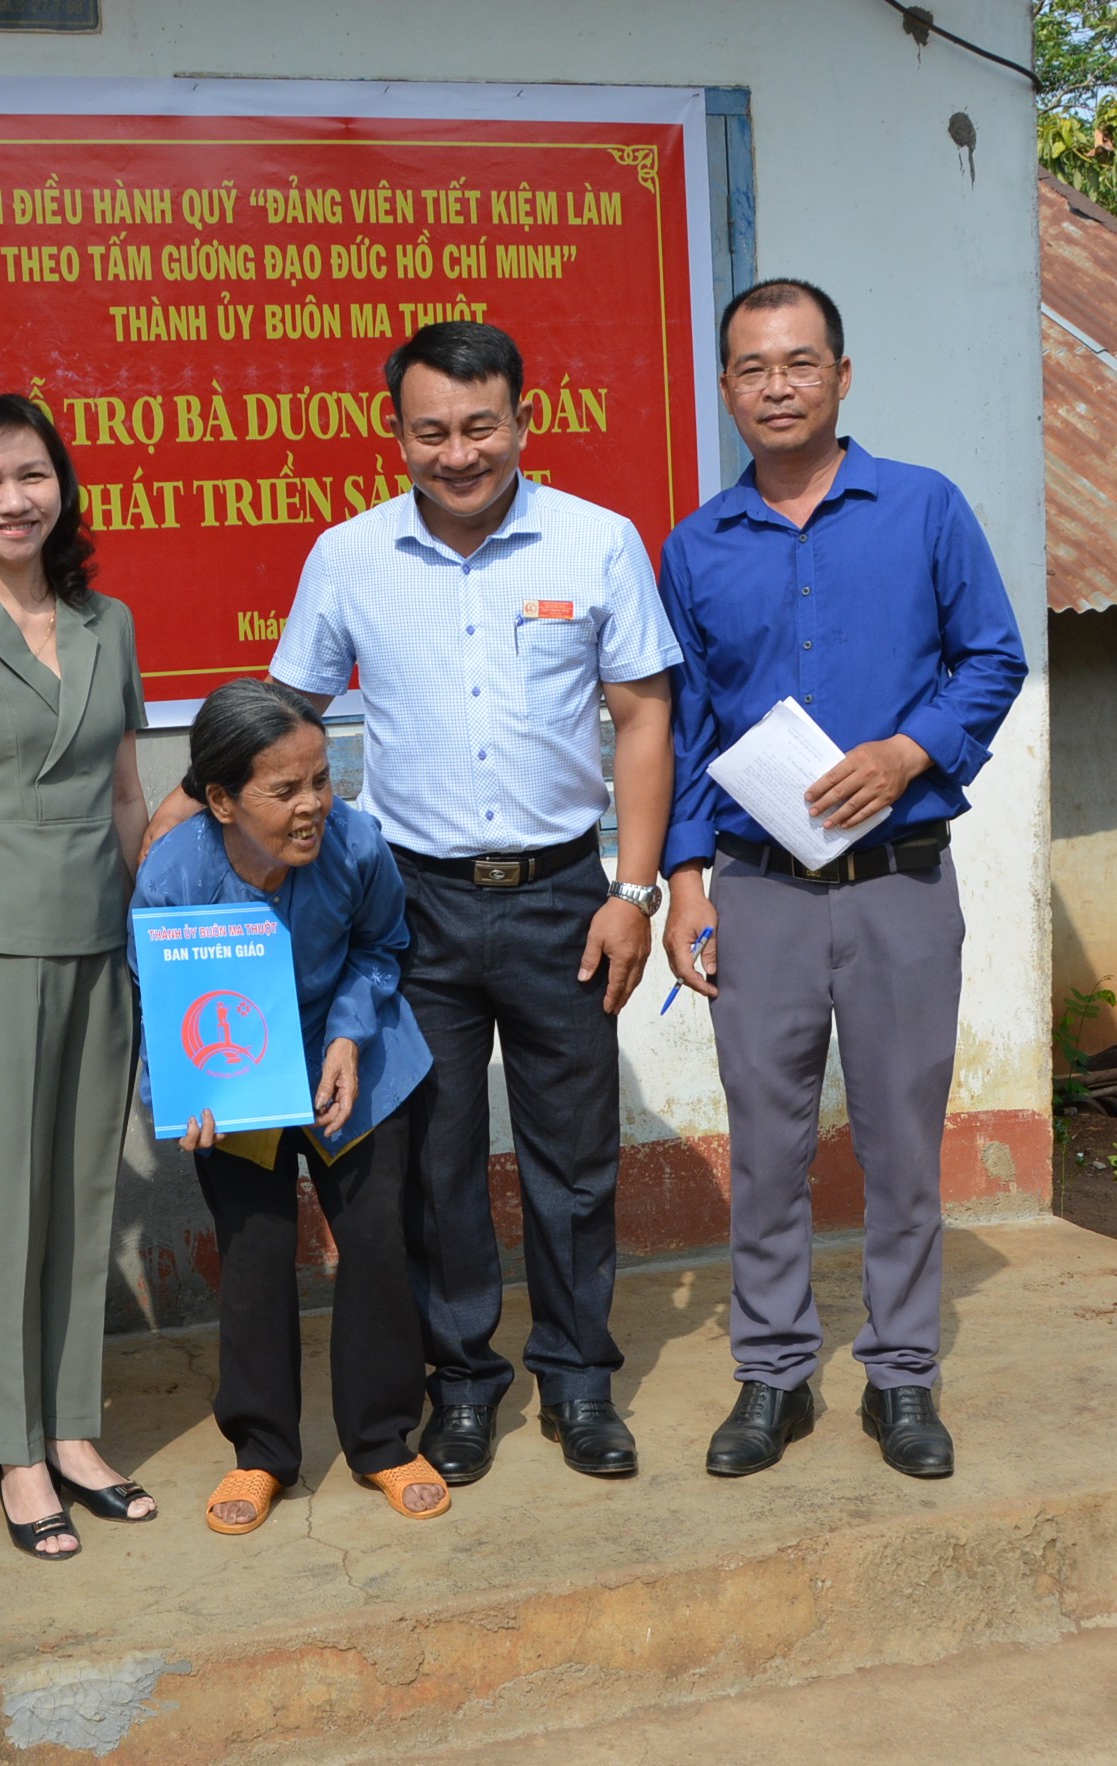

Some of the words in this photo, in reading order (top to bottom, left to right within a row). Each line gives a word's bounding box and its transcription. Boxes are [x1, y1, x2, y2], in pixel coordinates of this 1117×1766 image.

[12, 173, 83, 225] ĐIỀU
[94, 180, 173, 224] HÀNH
[182, 180, 237, 230] QUỸ
[350, 180, 414, 223] VIÊN
[422, 176, 481, 224] TIẾT
[491, 182, 559, 231] KIỆM
[568, 183, 622, 225] LÀM
[1, 246, 80, 283] THEO
[88, 231, 152, 281] TẤM
[162, 238, 256, 281] GƯƠNG
[264, 244, 322, 287] ĐẠO
[330, 235, 388, 279] ĐỨC
[397, 229, 434, 279] HỒ
[443, 236, 487, 279] CHÍ
[109, 297, 208, 341] THÀNH
[217, 291, 254, 340] ỦY
[265, 295, 342, 340] BUÔN
[351, 303, 393, 338] MA
[63, 395, 165, 454] TRỢ
[174, 380, 238, 442] BÀ
[148, 926, 182, 941] THÀNH
[184, 923, 197, 939] ỦY
[199, 924, 227, 938] BUÔN
[228, 926, 244, 936] MA
[244, 920, 278, 936] THUỘT
[163, 948, 189, 962] BAN
[192, 943, 232, 960] TUYÊN
[235, 941, 265, 958] GIÁO
